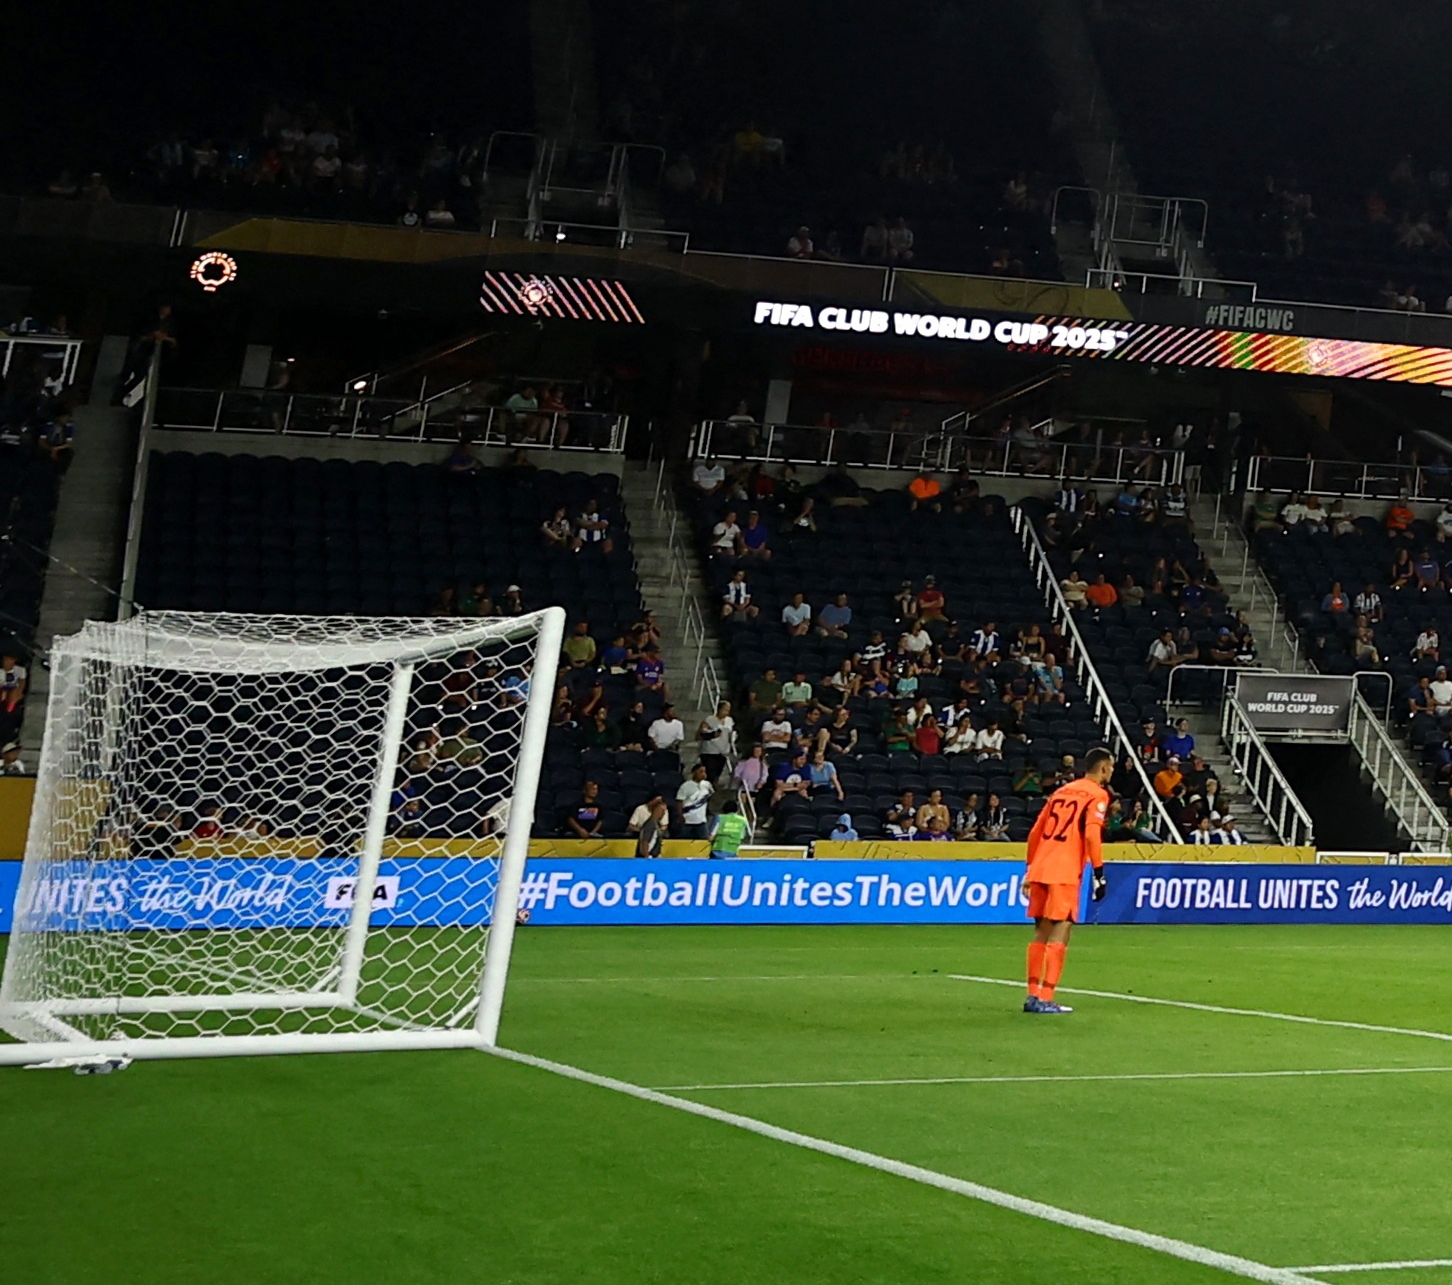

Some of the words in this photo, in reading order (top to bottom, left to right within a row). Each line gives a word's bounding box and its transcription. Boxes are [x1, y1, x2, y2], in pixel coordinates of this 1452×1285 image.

[754, 301, 813, 327] FIFA
[818, 306, 888, 333] CLUB
[893, 312, 990, 342] WORLD
[994, 321, 1049, 345] CUP
[1205, 305, 1294, 331] #FIFACWC
[1247, 702, 1286, 713] WORLD
[1286, 704, 1308, 714] CUP
[1266, 691, 1289, 702] FIFA
[1290, 692, 1318, 703] CLUB
[1042, 798, 1078, 843] 52
[1135, 876, 1254, 910] FOOTBALL
[1257, 877, 1340, 910] UNITES
[1346, 879, 1386, 910] the
